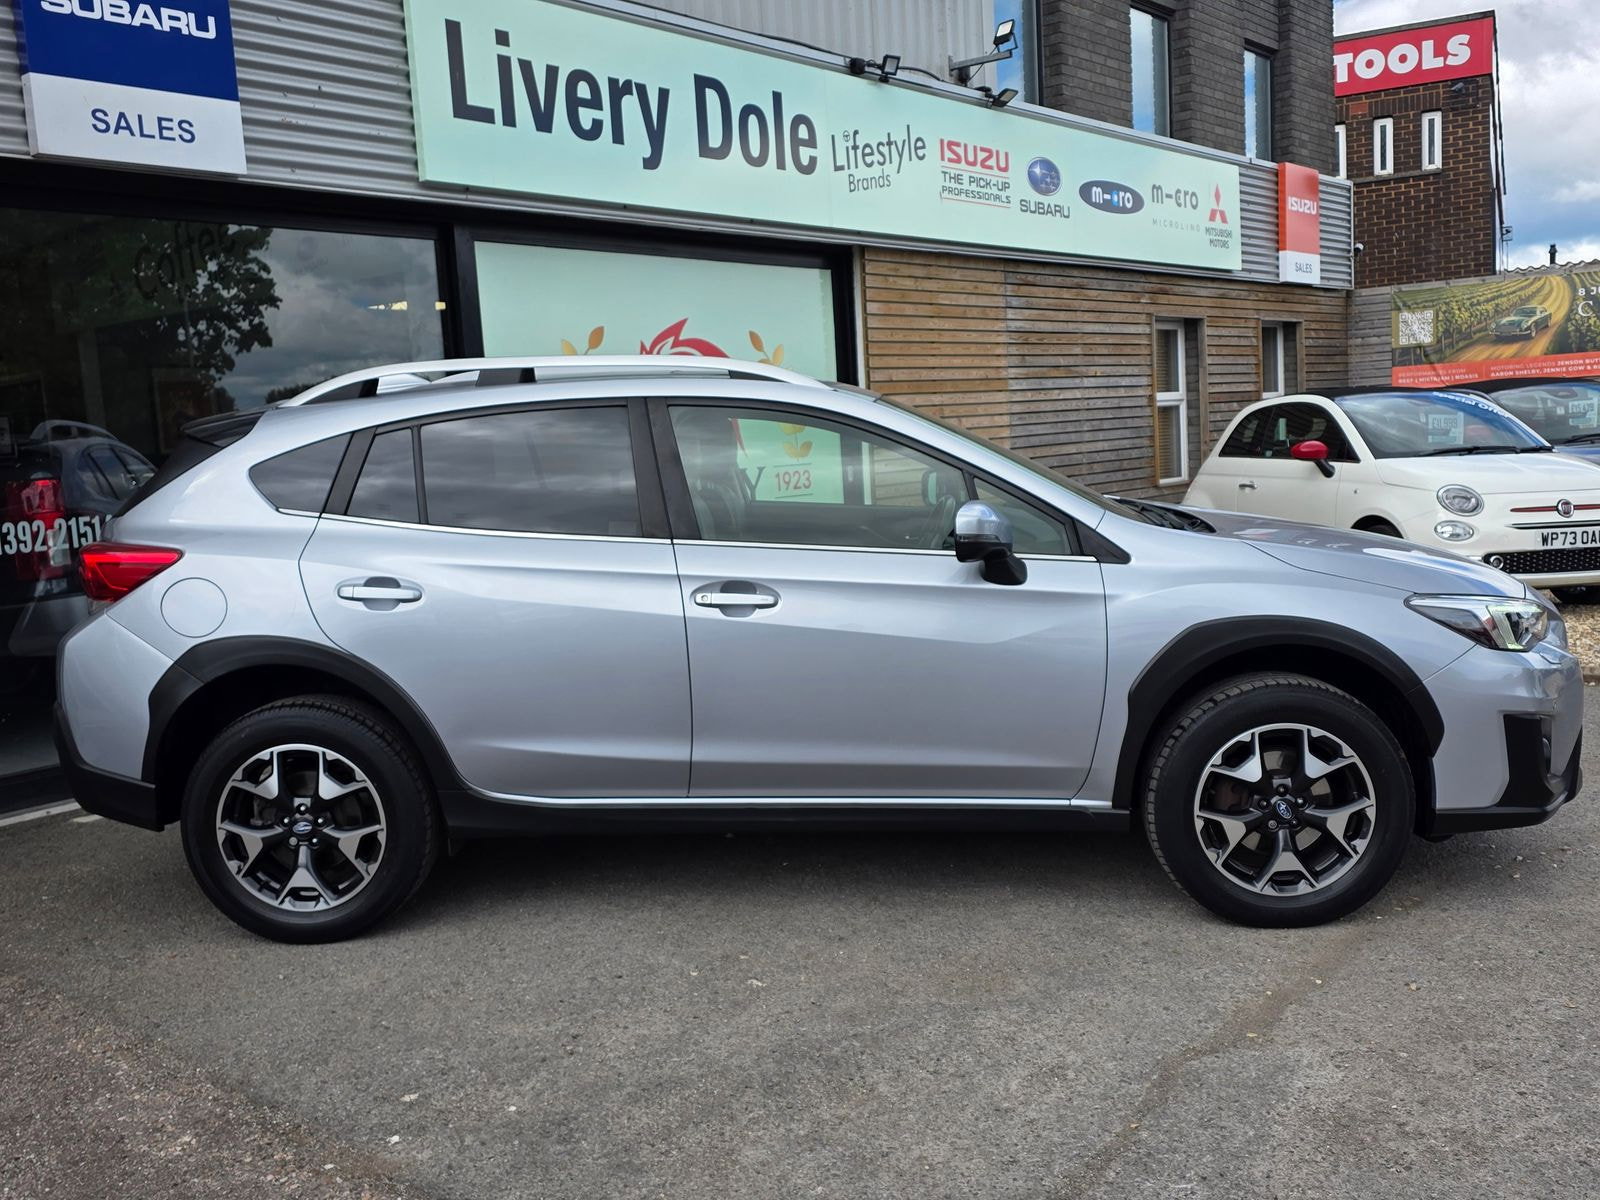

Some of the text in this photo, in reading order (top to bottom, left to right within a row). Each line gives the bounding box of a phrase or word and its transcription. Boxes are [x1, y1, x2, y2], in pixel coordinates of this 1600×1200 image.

[41, 0, 217, 40] SUBARU
[1333, 34, 1472, 84] TOOLS
[444, 18, 819, 176] Livery Dole
[90, 108, 196, 144] SALES
[831, 124, 927, 174] Lifestyle
[939, 138, 1010, 173] ISUZU
[847, 168, 892, 193] Brands
[941, 170, 1011, 193] THE PICK-UP
[941, 185, 1012, 205] PROFESSIONALS
[1287, 195, 1318, 216] ISUZU
[1019, 198, 1071, 219] SUBARU
[1204, 226, 1233, 240] MITSUBISHI
[1209, 237, 1231, 250] MOTORS
[1294, 262, 1313, 275] SALES
[1578, 287, 1586, 296] 8
[774, 469, 812, 492] 1923
[0, 521, 48, 556] 392
[1541, 530, 1600, 547] WP73 OA
